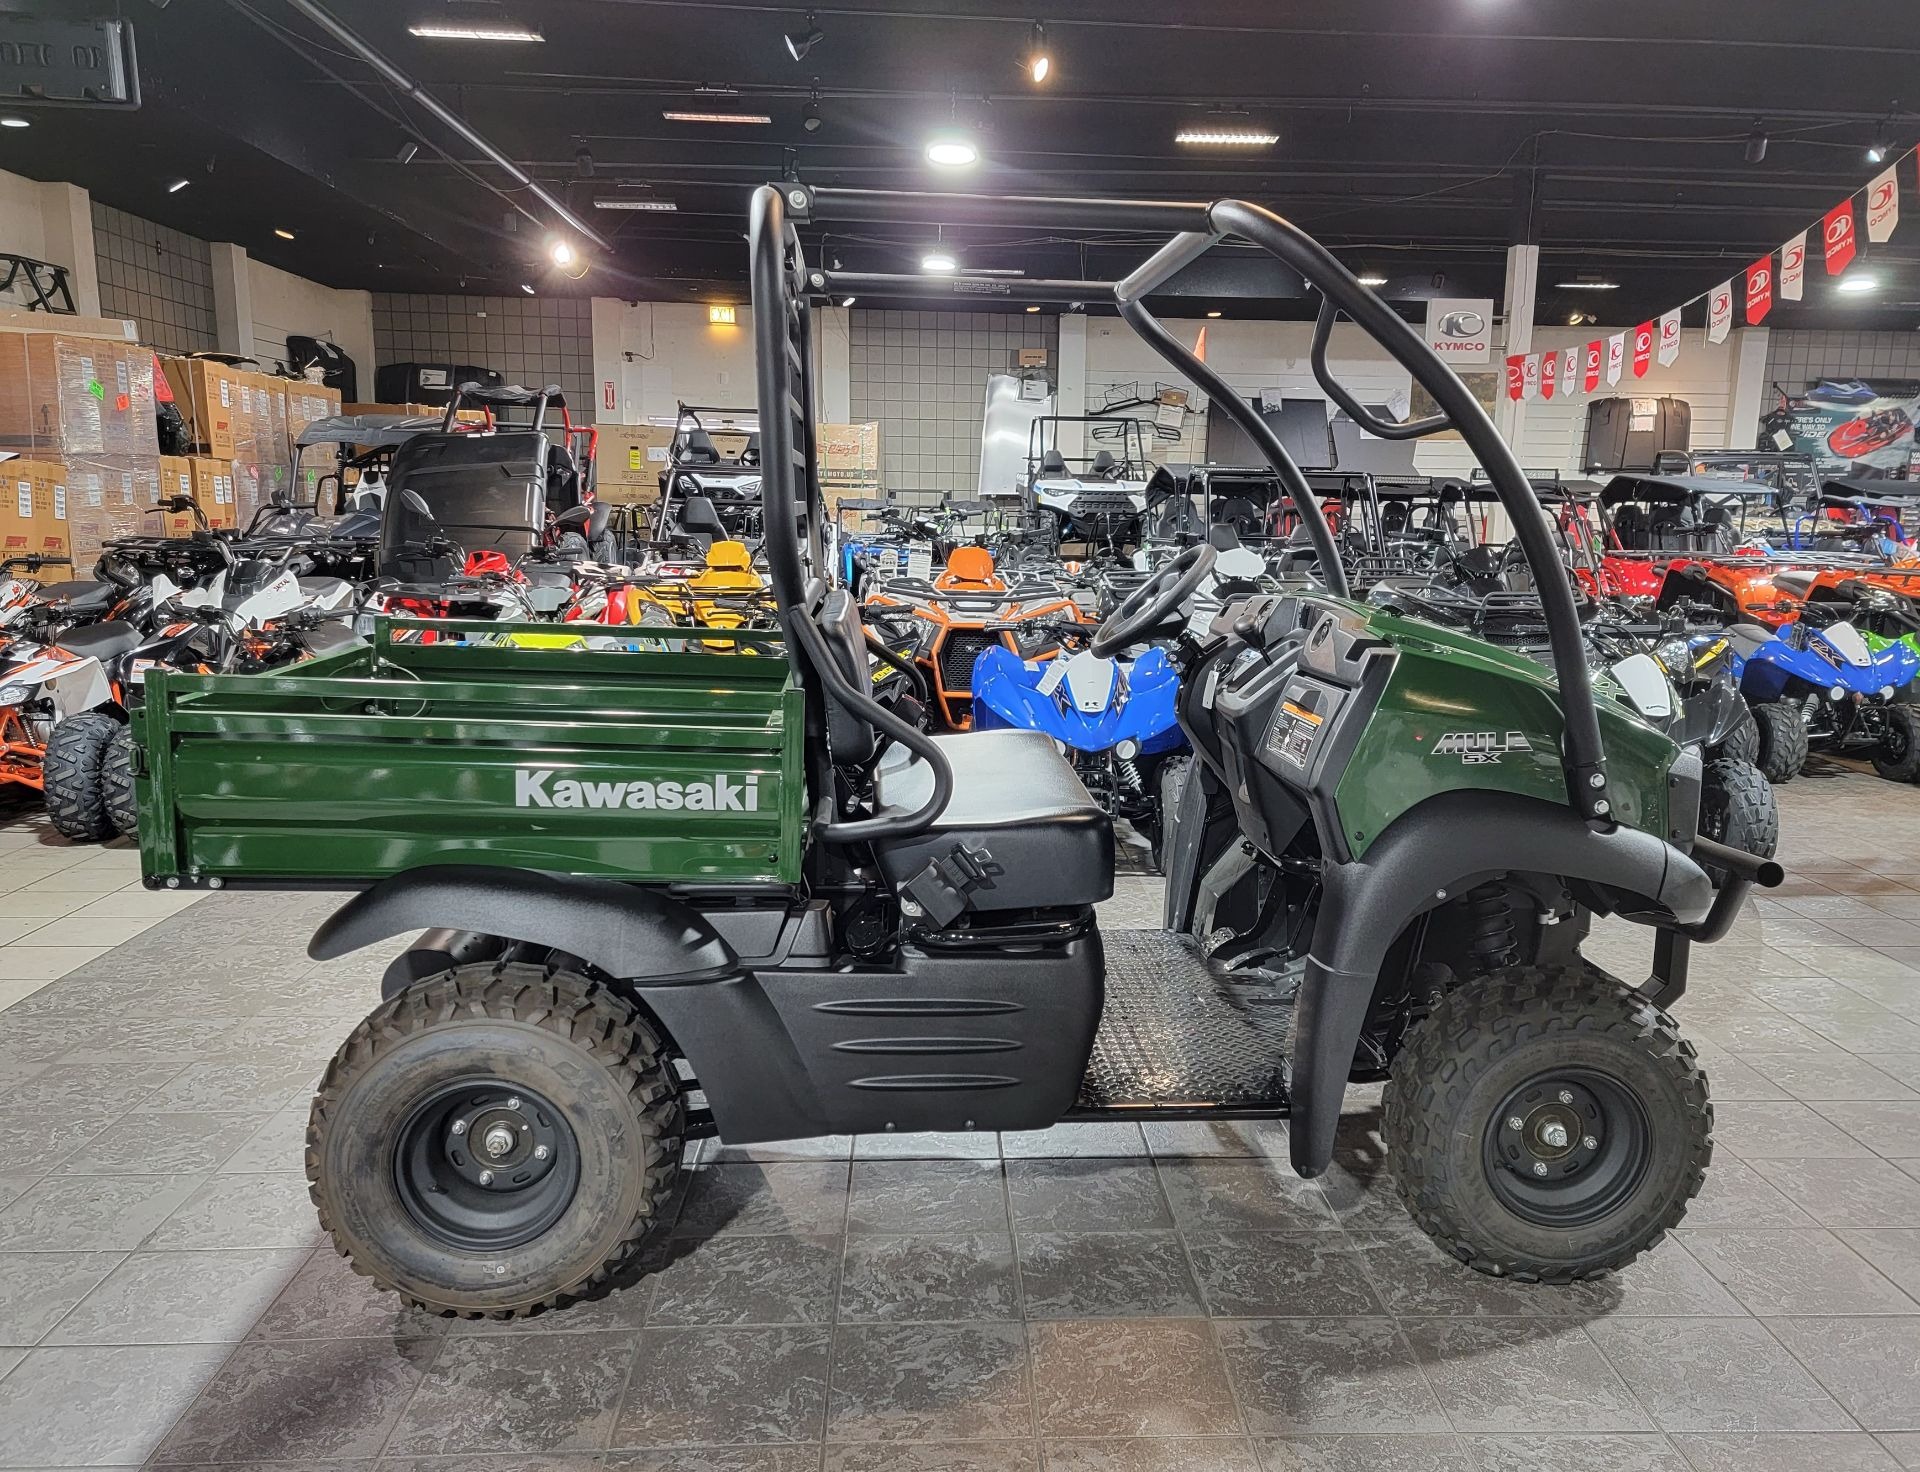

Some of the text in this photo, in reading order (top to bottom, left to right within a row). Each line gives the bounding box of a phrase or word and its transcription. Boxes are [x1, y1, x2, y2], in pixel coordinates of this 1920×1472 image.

[711, 307, 733, 321] EXIT
[1434, 342, 1485, 351] KYMCO
[1815, 416, 1832, 424] ONLY
[1431, 731, 1533, 754] MULE
[1462, 752, 1502, 764] SX
[515, 769, 758, 811] Kawasaki
